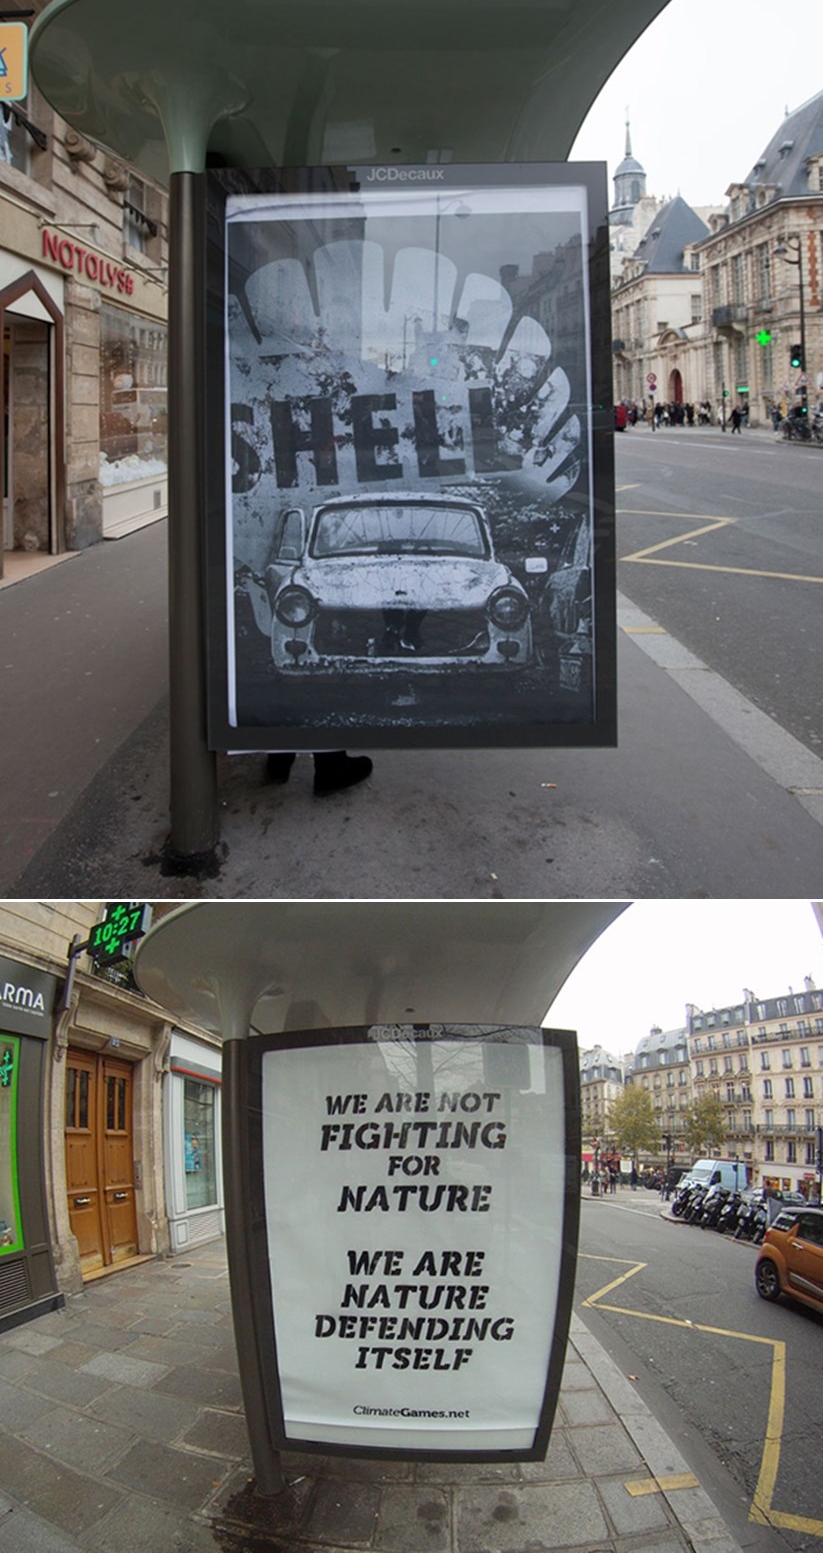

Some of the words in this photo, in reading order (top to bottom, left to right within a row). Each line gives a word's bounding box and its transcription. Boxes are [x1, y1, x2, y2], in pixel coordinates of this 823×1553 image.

[366, 167, 445, 182] JCDecaux
[230, 386, 524, 494] SHELL
[93, 911, 141, 946] 10:27
[373, 1027, 443, 1040] JCDecaux
[326, 1094, 368, 1115] WE
[374, 1092, 430, 1113] ARE
[437, 1092, 501, 1113] NOT
[320, 1121, 507, 1151] FIGHTING
[388, 1155, 441, 1176] FOR
[337, 1185, 493, 1213] NATURE
[347, 1250, 404, 1276] WE
[412, 1251, 485, 1277] ARE
[341, 1283, 490, 1310] NATURE
[315, 1314, 515, 1341] DEFENDING
[355, 1346, 473, 1371] ITSELF
[353, 1404, 471, 1419] ClimateGames.net
